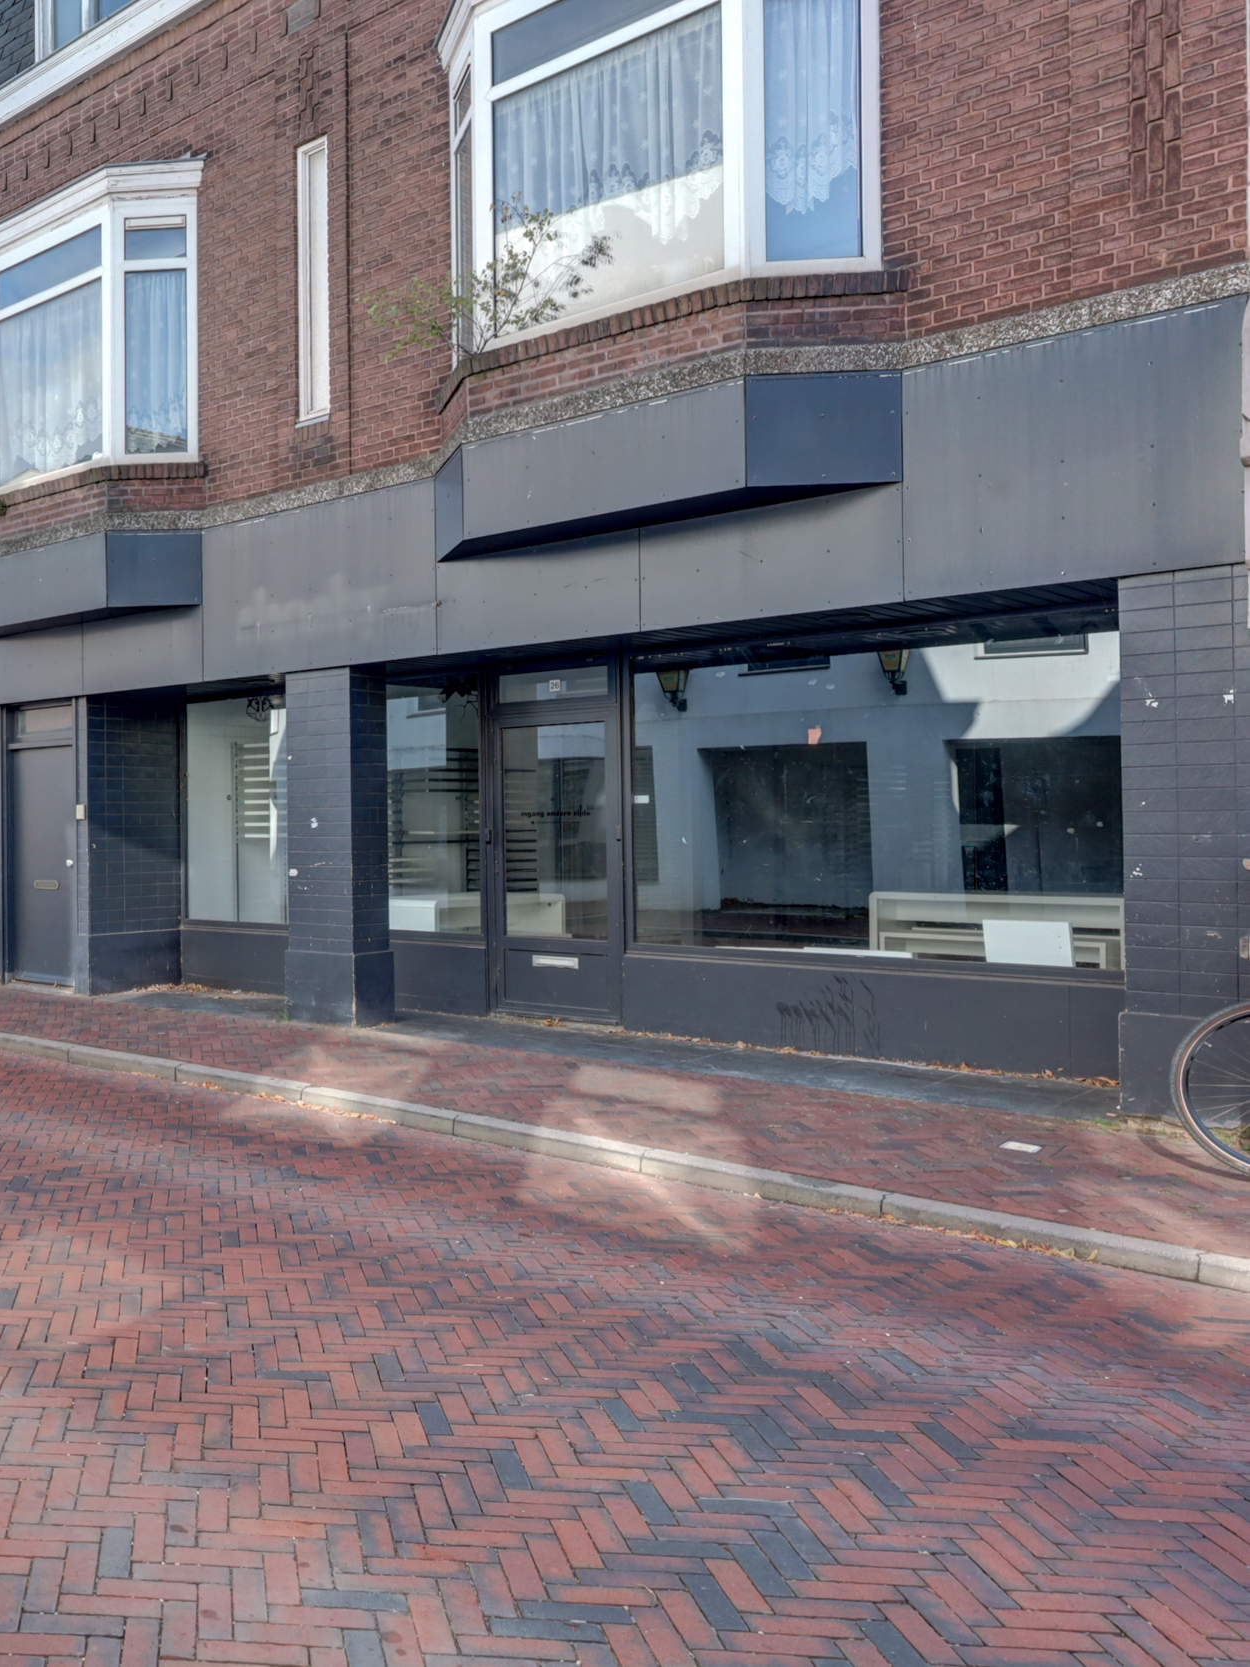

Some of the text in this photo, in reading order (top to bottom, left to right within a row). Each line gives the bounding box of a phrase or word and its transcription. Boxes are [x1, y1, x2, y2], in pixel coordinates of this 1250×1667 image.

[550, 681, 560, 690] 26
[546, 809, 572, 817] andere
[573, 804, 592, 818] zijde
